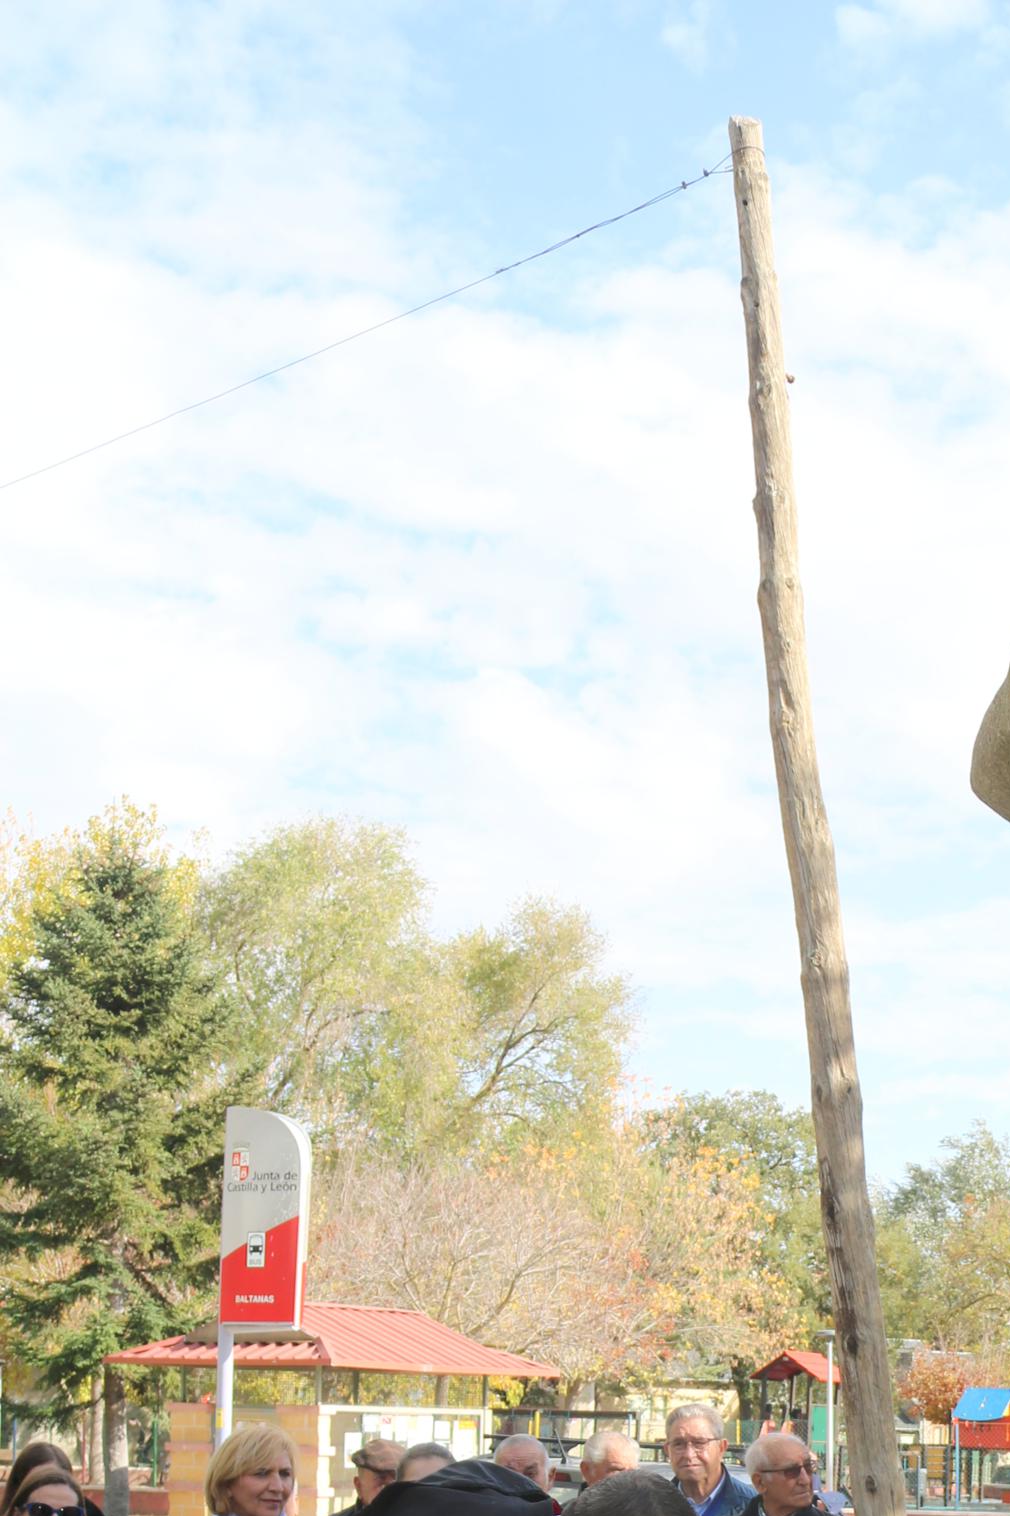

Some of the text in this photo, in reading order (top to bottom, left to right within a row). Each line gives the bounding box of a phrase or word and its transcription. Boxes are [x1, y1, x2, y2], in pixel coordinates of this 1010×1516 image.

[253, 1171, 298, 1181] Junta de
[227, 1182, 297, 1193] Castilla y León
[234, 1294, 275, 1304] BALTANAS
